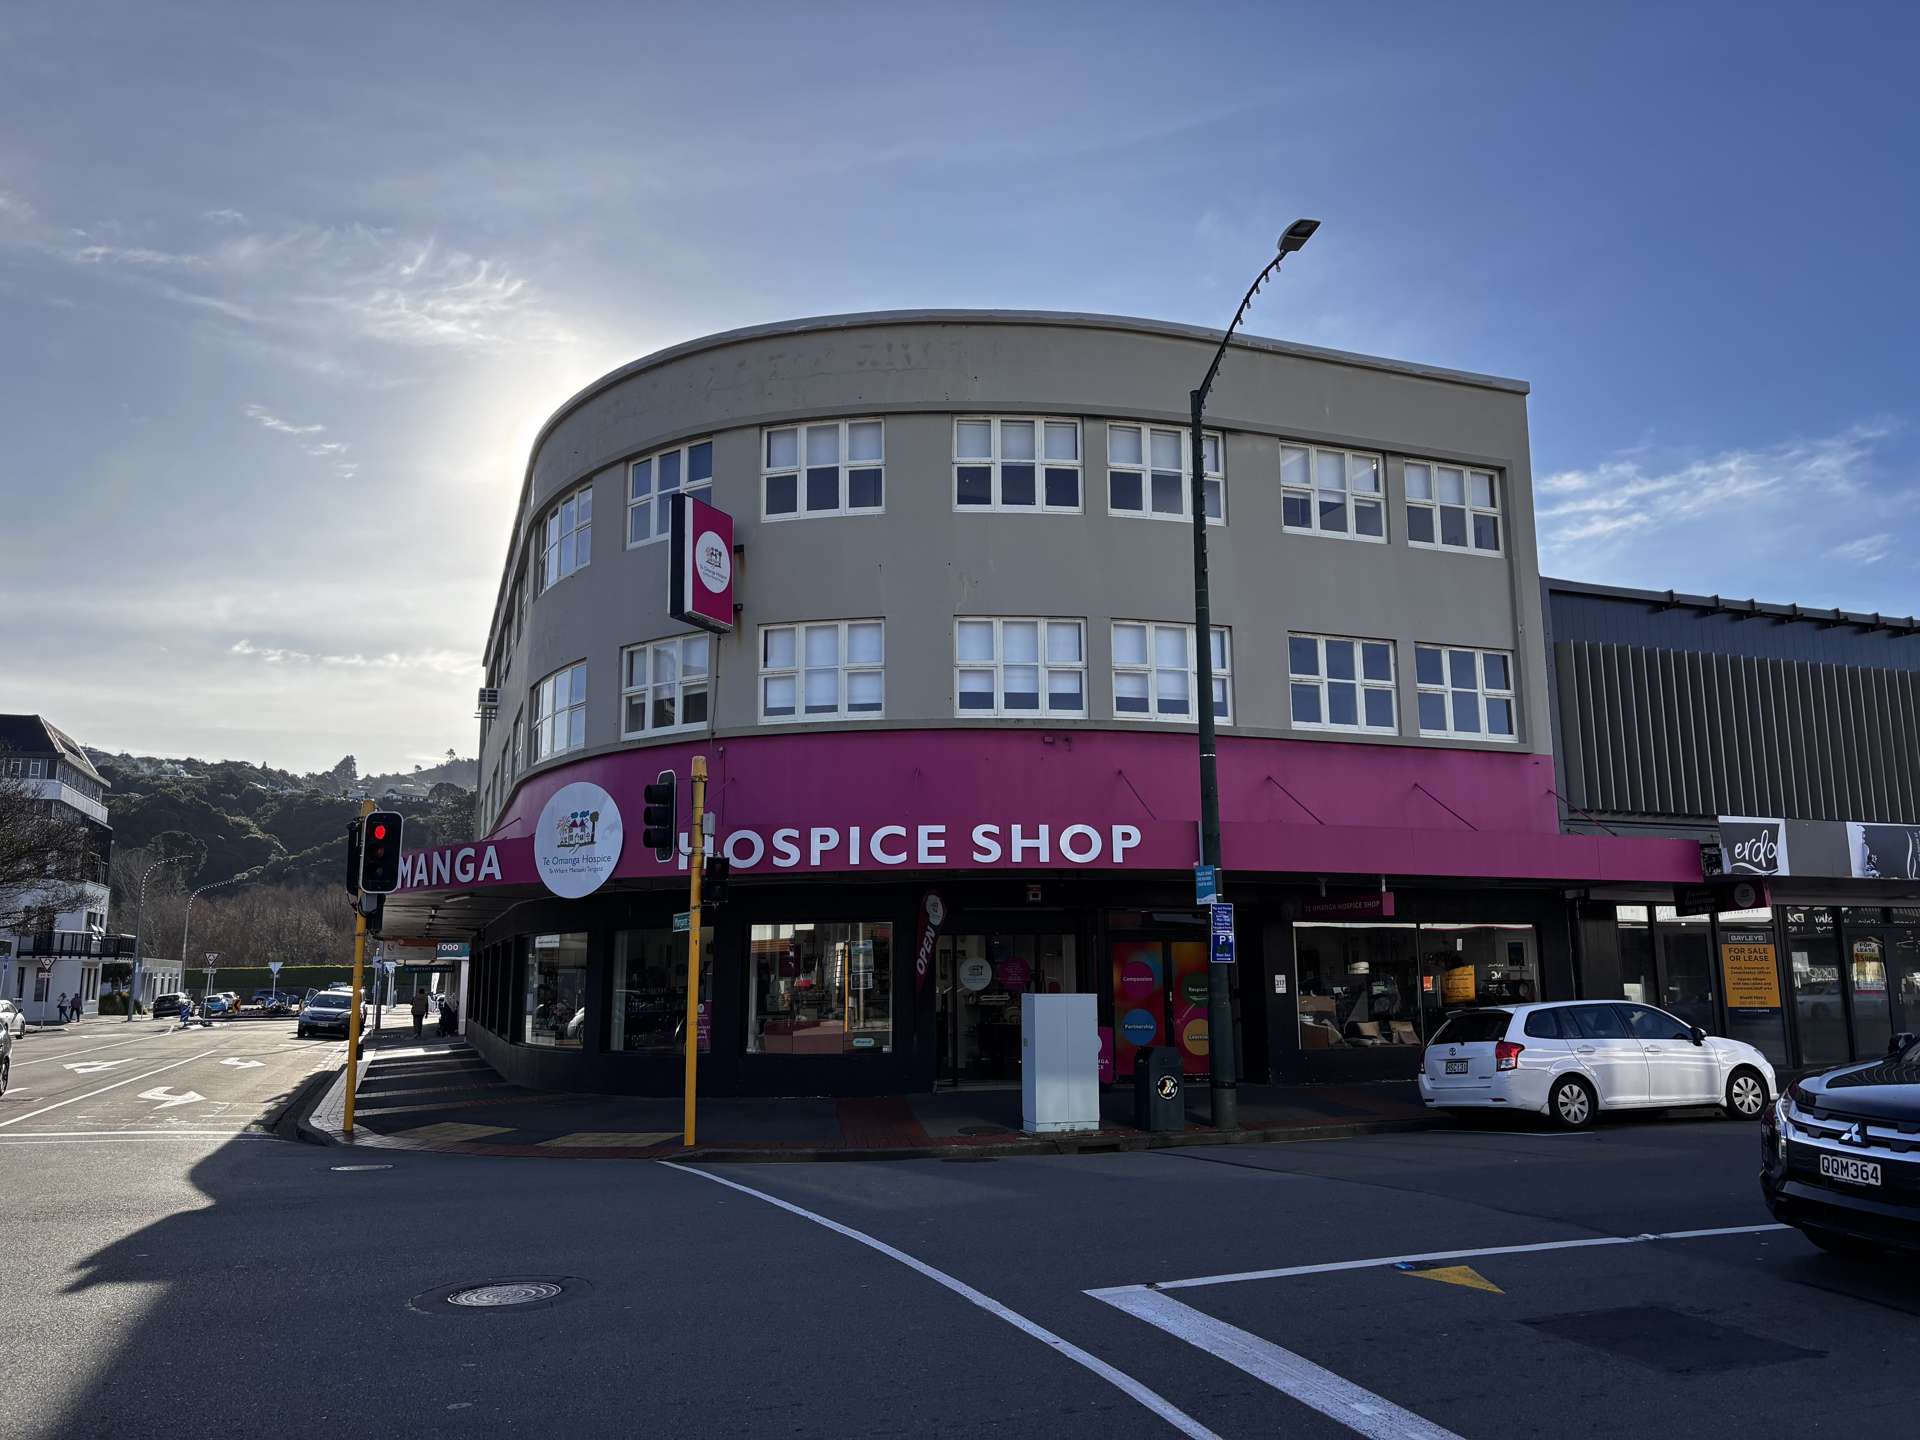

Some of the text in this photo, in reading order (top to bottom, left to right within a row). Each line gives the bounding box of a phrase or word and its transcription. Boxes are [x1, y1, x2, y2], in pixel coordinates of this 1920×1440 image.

[552, 856, 580, 866] Omanga
[582, 854, 612, 864] Hospice
[678, 823, 1142, 871] HOSPICE SHOP
[916, 925, 936, 975] OPEN
[1821, 1156, 1879, 1183] QQM364
